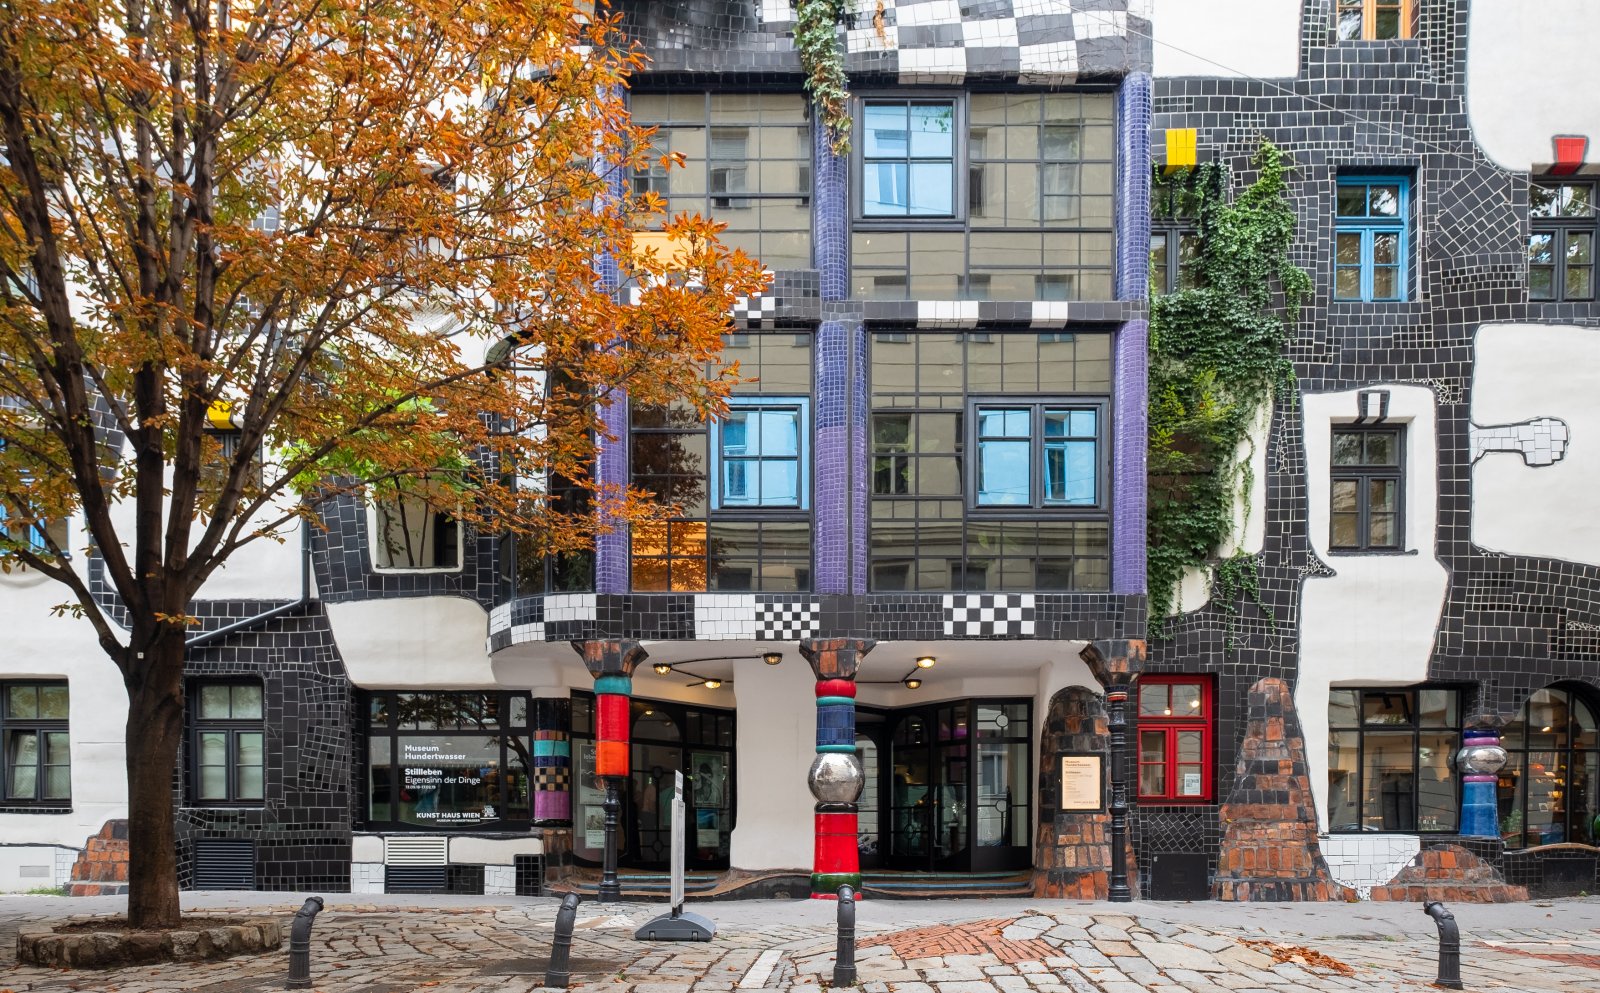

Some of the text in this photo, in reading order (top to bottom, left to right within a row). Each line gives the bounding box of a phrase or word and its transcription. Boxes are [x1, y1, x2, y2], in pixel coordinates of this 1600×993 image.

[404, 744, 439, 752] Museum
[404, 768, 443, 776] Stillleben
[405, 776, 481, 785] Eigensinn der Dinge
